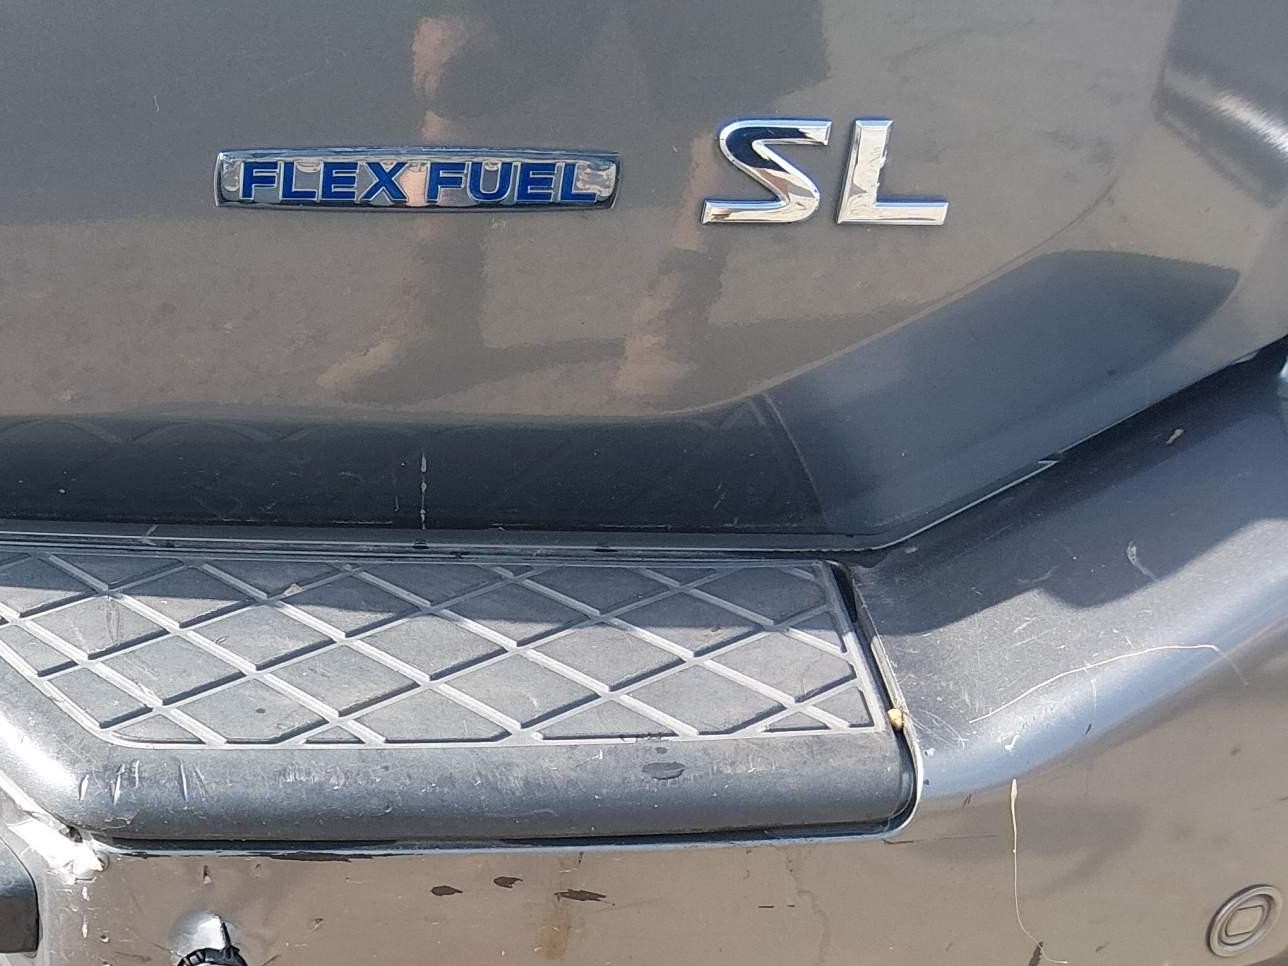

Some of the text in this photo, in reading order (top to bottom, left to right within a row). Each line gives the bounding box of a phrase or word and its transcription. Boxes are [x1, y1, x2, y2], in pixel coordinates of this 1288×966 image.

[239, 159, 599, 202] FLEX FUEL
[702, 117, 949, 226] SL
